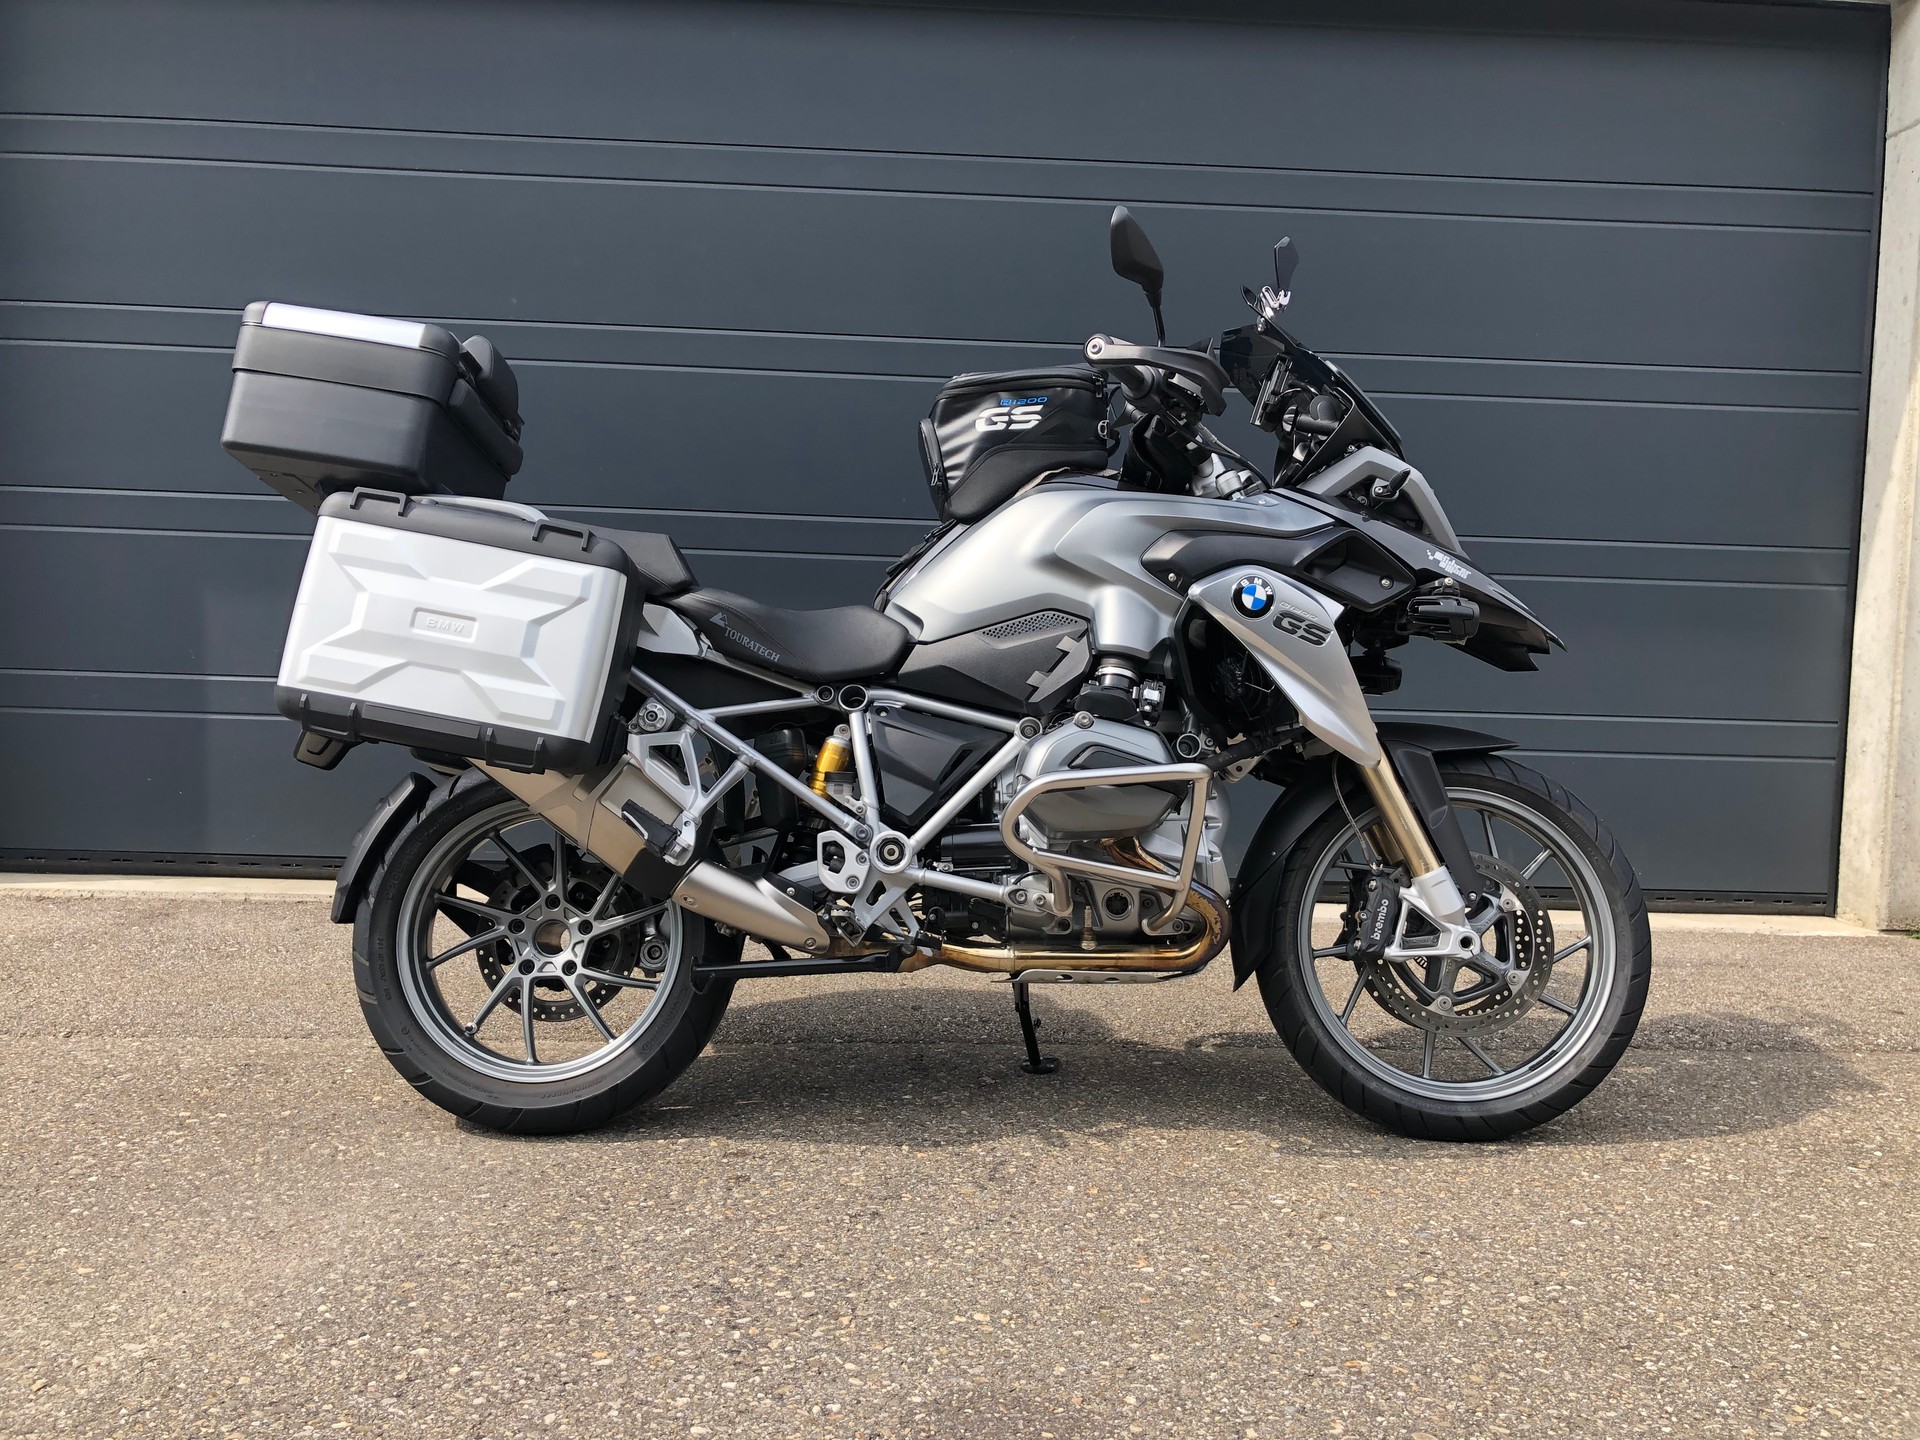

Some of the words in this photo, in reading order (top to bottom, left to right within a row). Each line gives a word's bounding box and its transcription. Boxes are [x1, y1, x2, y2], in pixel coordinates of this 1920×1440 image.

[975, 404, 1044, 432] GS
[1240, 577, 1273, 595] BMW
[426, 617, 465, 633] BMW
[1273, 610, 1334, 646] GS
[724, 626, 781, 662] TOURATECH
[1371, 899, 1389, 940] brembo
